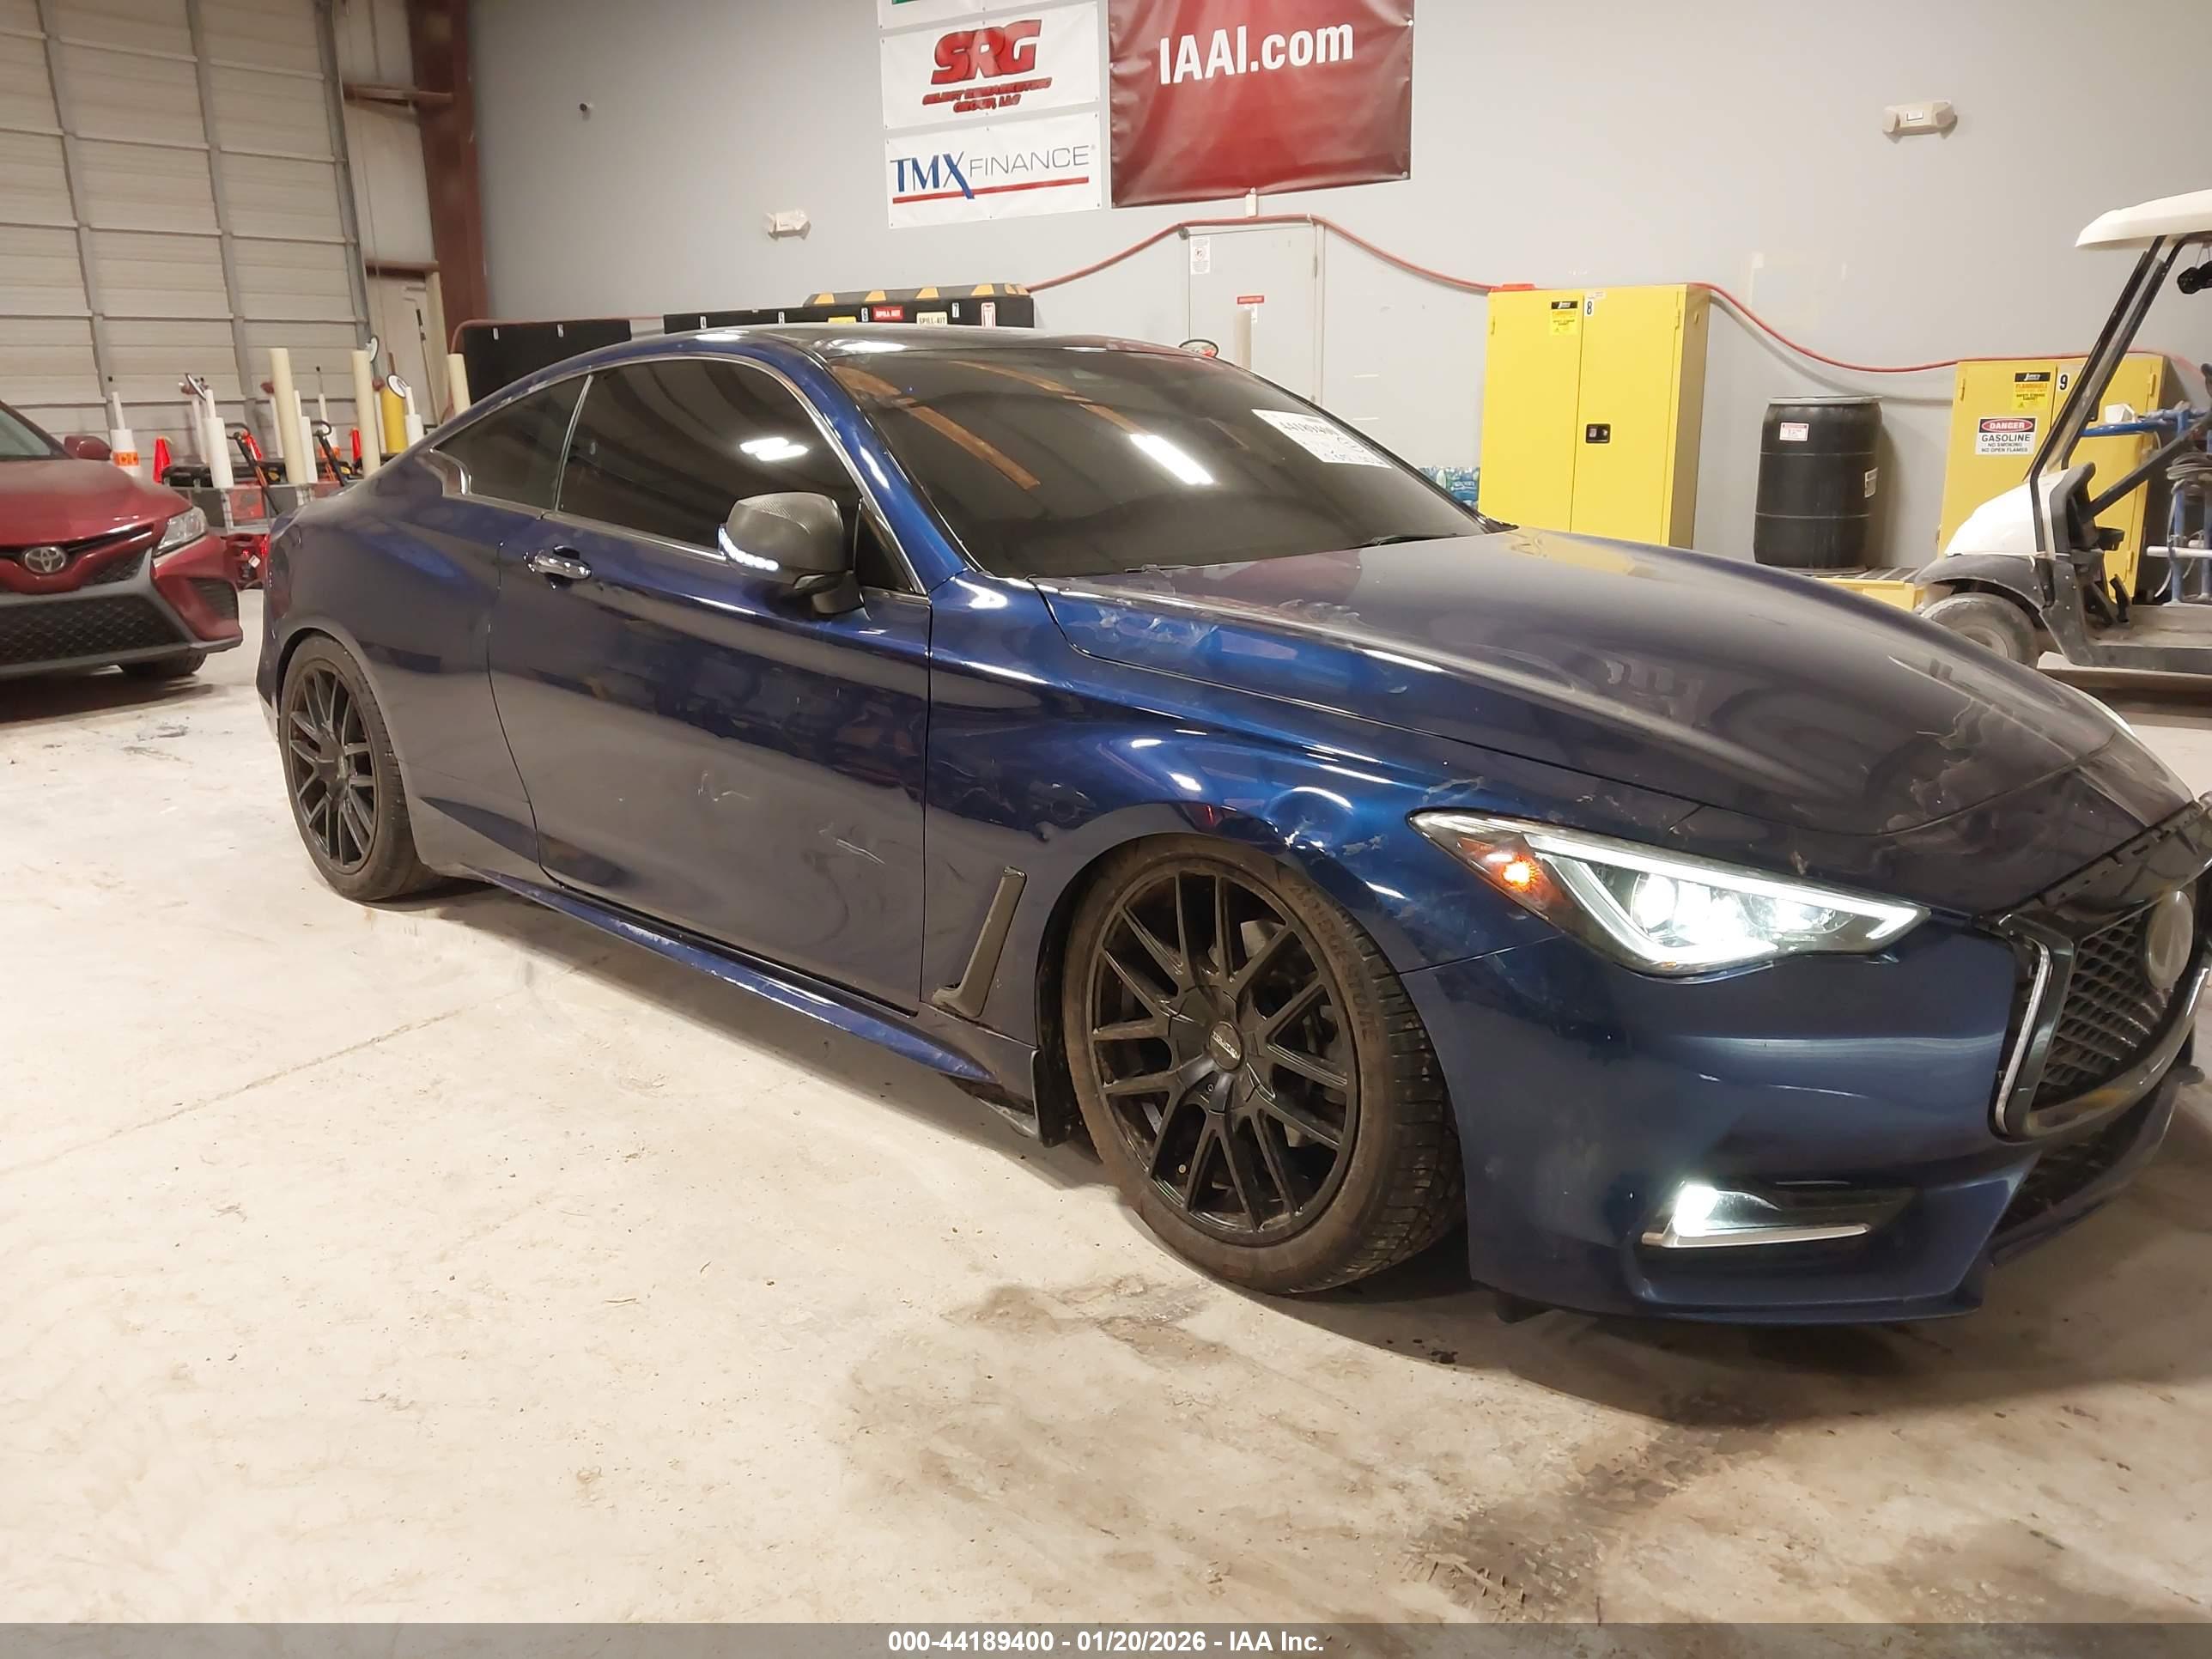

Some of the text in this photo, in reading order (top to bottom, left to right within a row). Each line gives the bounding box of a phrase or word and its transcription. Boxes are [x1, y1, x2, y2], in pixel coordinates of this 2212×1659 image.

[931, 19, 1042, 84] SRG
[1160, 23, 1354, 85] IAAI.com
[890, 145, 1089, 199] TMX FINANCE
[1587, 301, 1592, 315] 8
[2060, 374, 2068, 390] 9
[1981, 434, 2031, 442] GASOLINE
